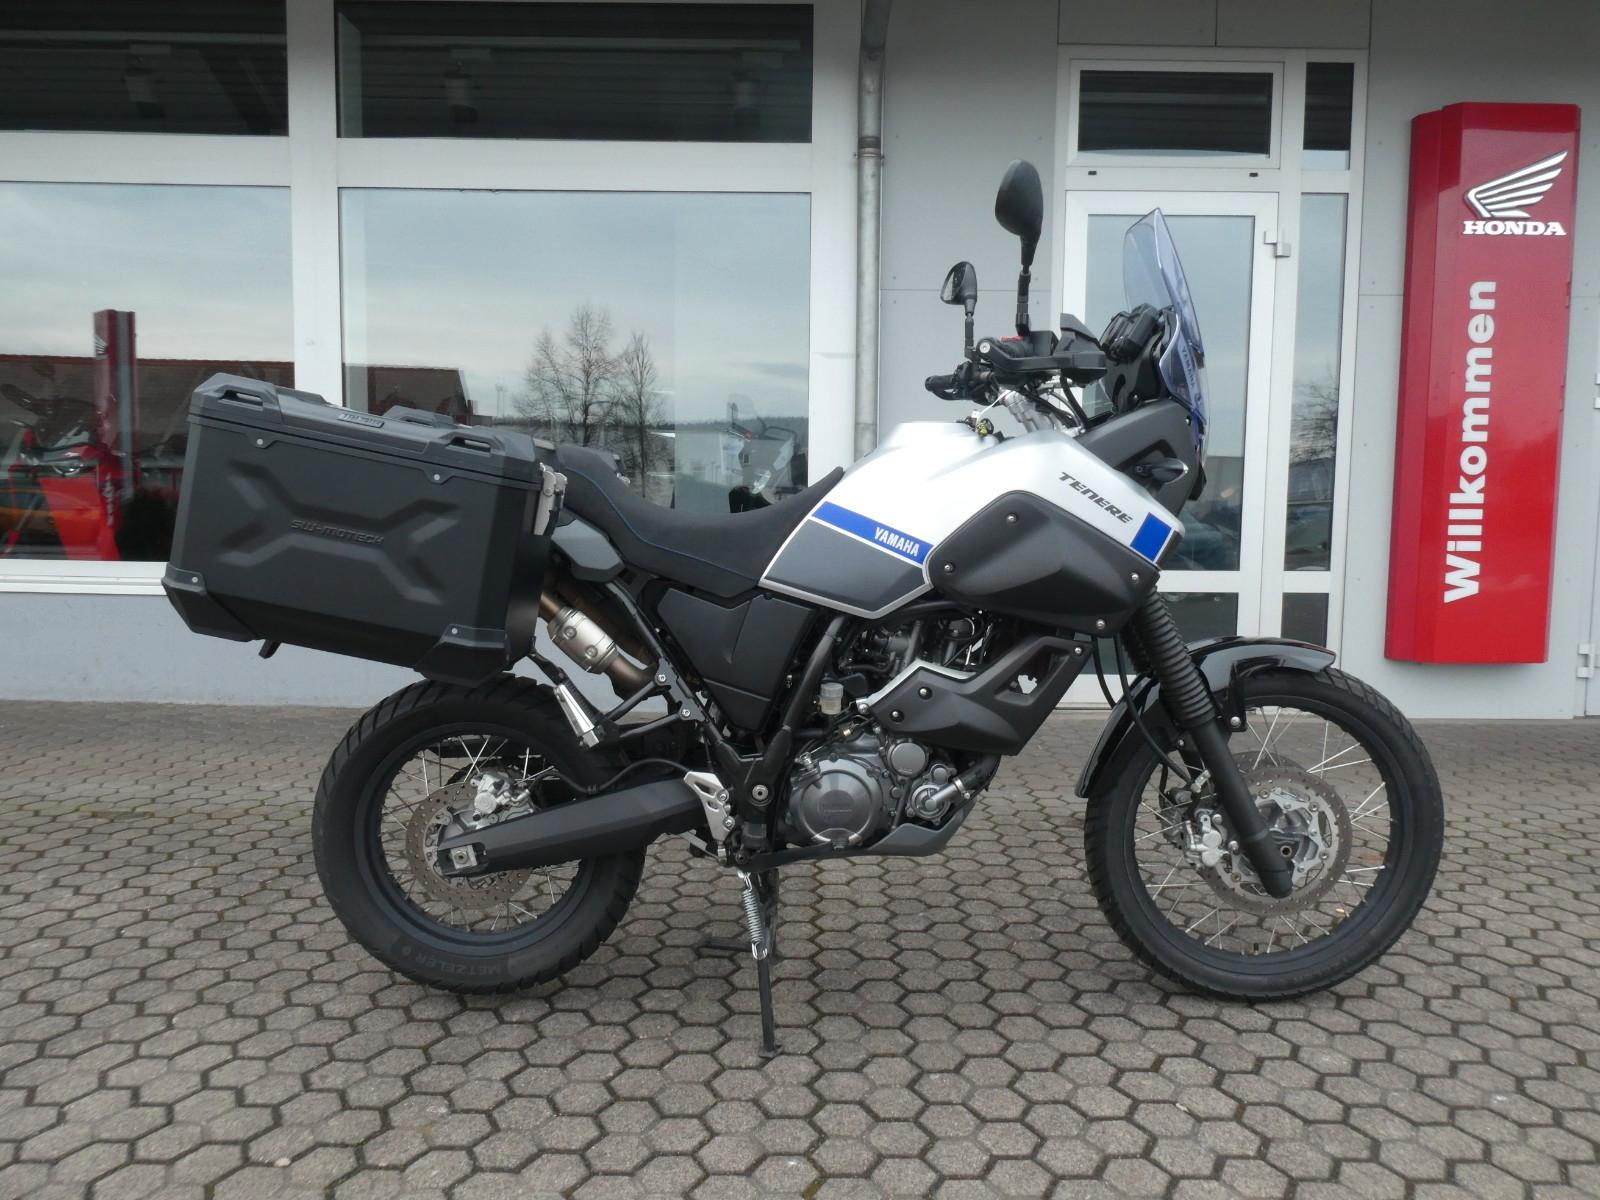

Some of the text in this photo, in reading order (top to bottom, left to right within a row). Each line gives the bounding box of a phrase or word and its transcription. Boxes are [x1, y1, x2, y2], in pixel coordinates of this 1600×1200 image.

[1463, 220, 1567, 236] HONDA
[1443, 281, 1497, 604] Willkommen
[1059, 471, 1133, 524] TENERE
[290, 519, 384, 545] SW-MOTECH
[874, 526, 920, 557] YAMAHA
